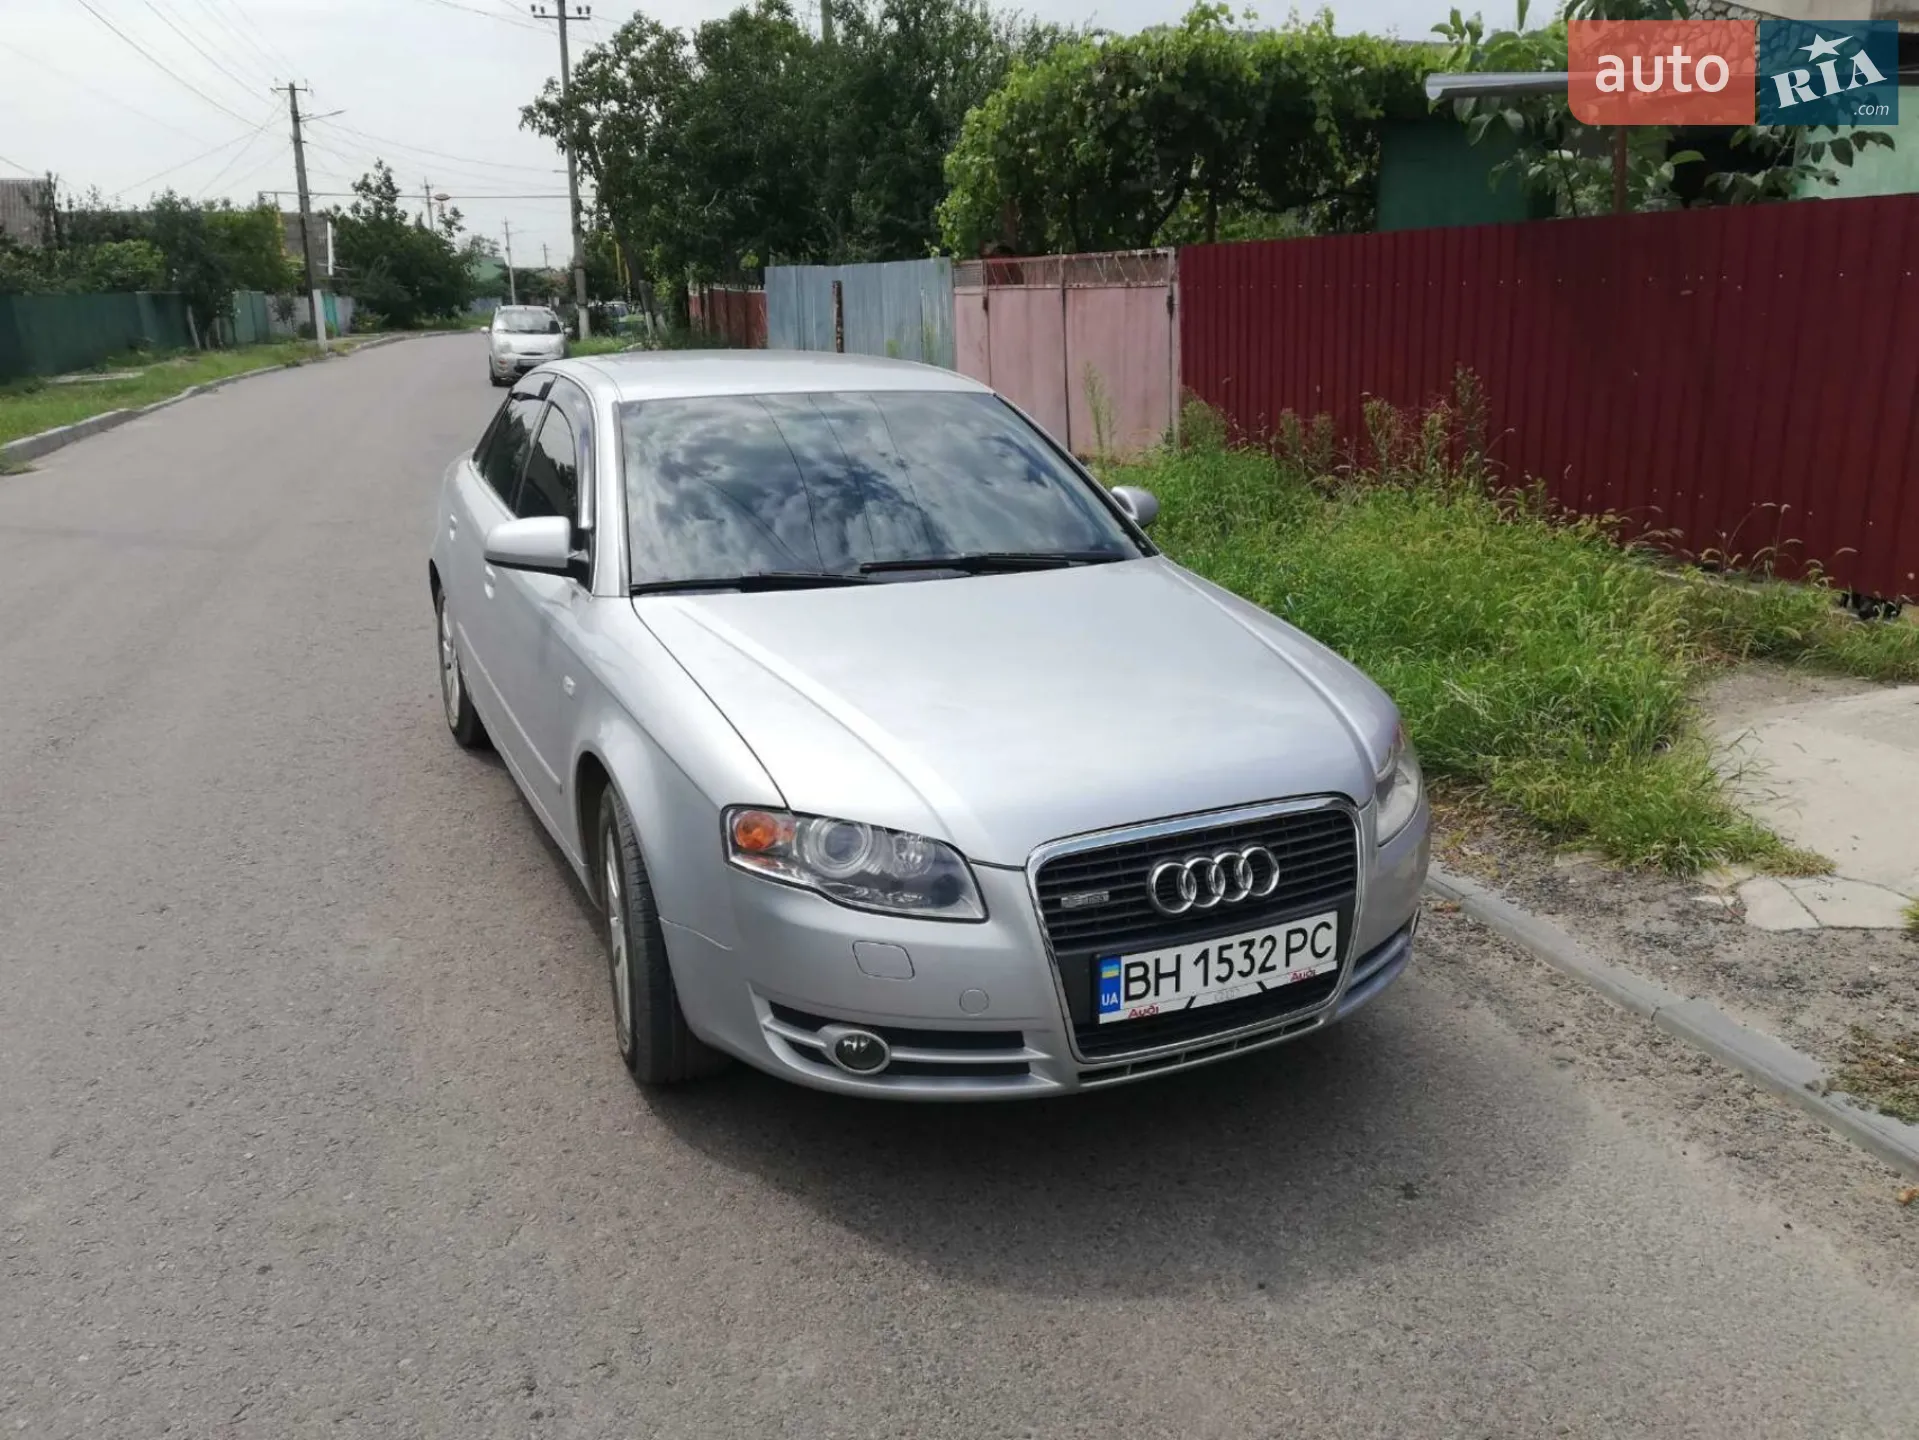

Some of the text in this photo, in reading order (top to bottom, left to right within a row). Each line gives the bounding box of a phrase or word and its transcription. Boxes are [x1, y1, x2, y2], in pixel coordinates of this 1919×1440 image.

[1124, 921, 1333, 1002] BH 1532 PC
[1101, 992, 1119, 1006] UA
[1128, 1003, 1160, 1019] Audi
